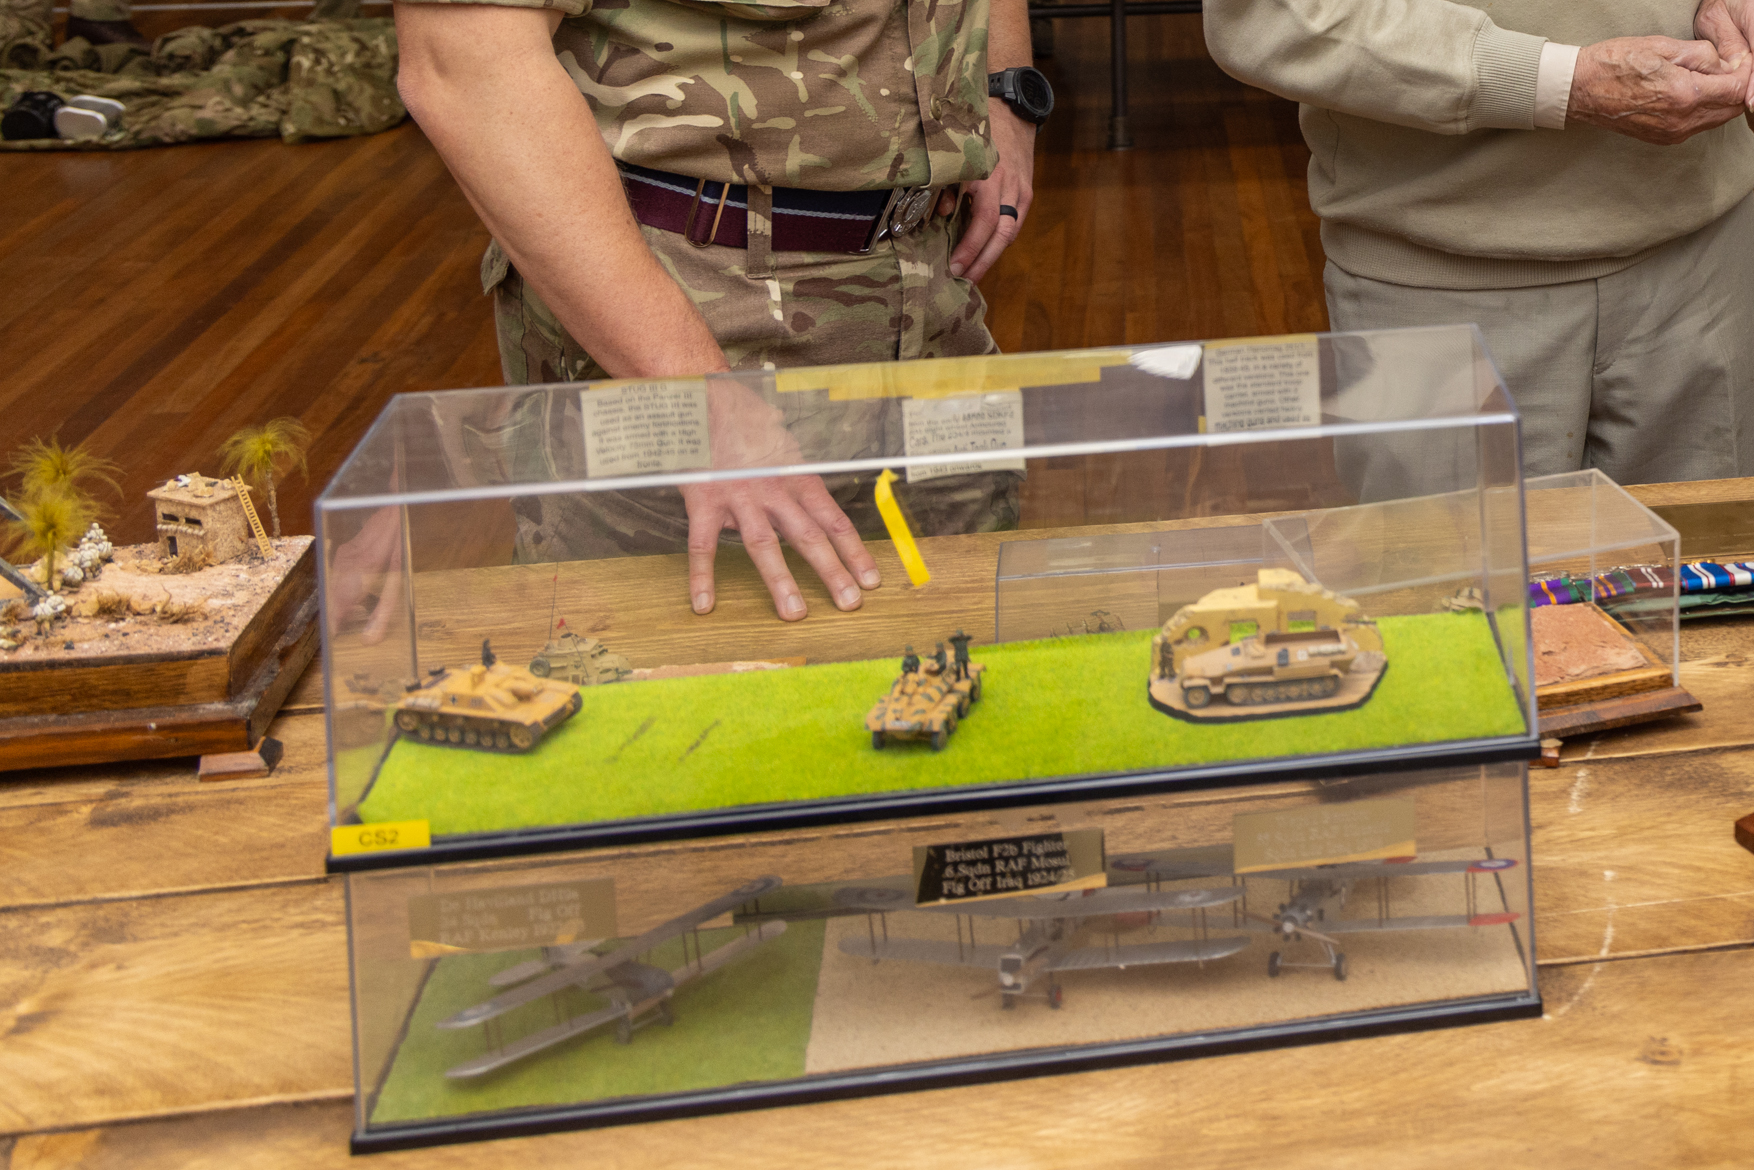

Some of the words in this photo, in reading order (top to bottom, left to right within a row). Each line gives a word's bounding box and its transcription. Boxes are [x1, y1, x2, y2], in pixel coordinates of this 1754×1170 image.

[359, 828, 398, 847] CS2
[944, 846, 989, 863] Bristol
[992, 842, 1019, 858] F2b
[1022, 839, 1068, 856] Fighter
[944, 867, 954, 878] 6
[957, 864, 991, 880] Sqdn
[995, 859, 1027, 873] RAF
[1031, 854, 1071, 870] Mosul
[942, 881, 966, 896] Flg
[968, 876, 991, 891] Off
[996, 875, 1023, 890] Iraq
